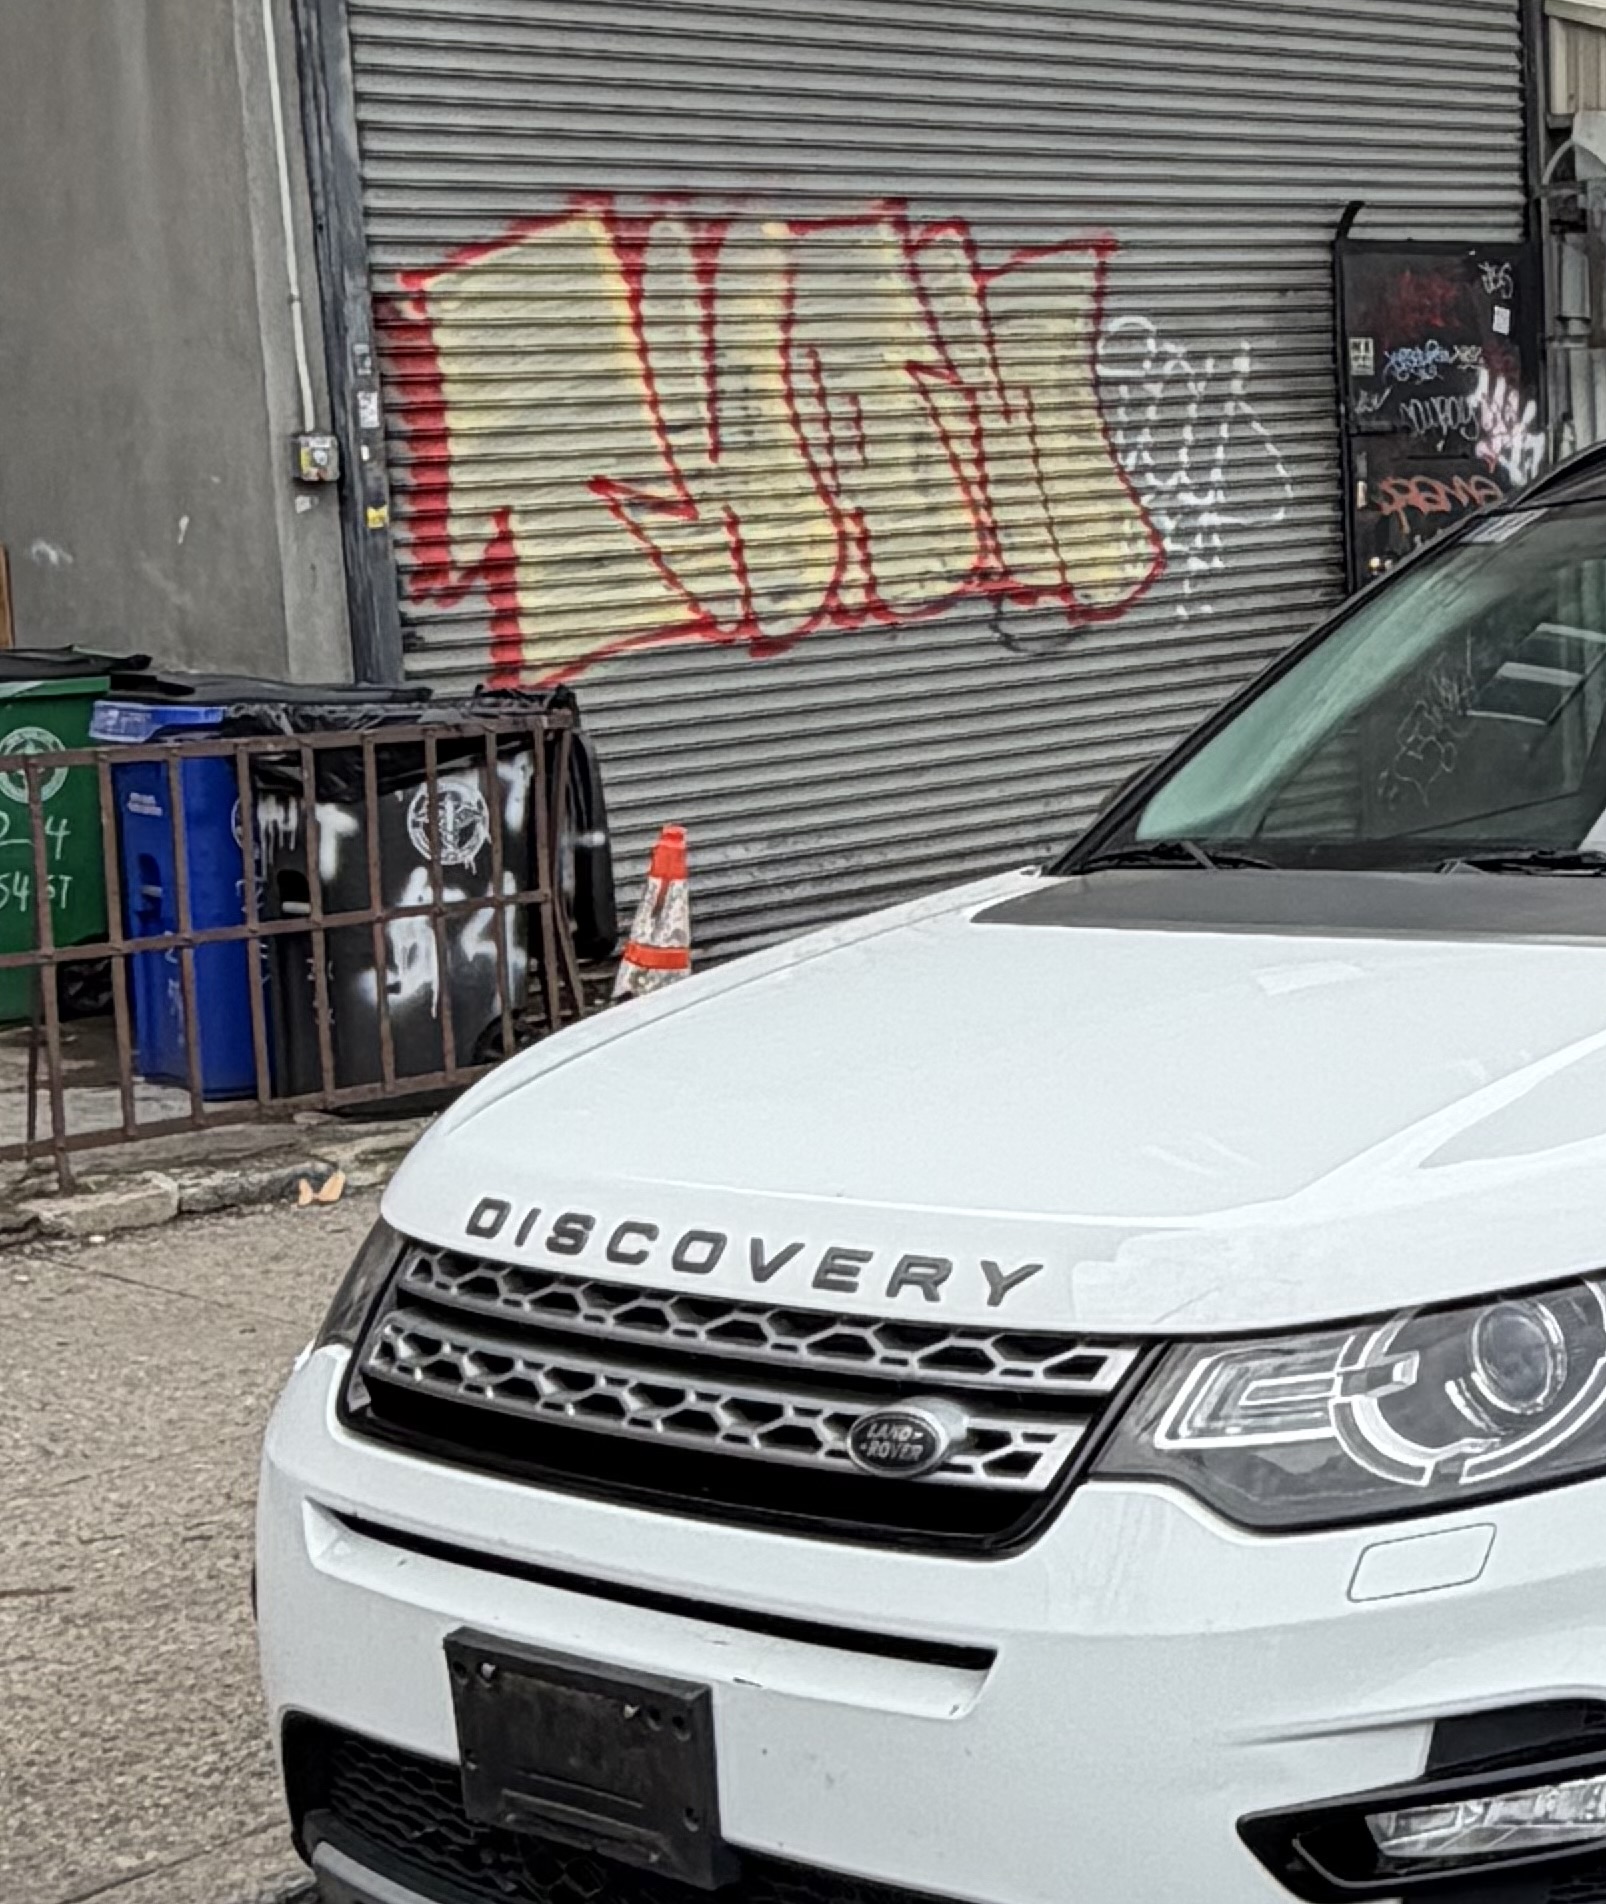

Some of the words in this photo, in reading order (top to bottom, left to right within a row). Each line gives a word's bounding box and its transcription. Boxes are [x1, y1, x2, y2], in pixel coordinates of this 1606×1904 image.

[464, 1196, 1044, 1307] DISCOVERY
[866, 1422, 913, 1441] LAND
[866, 1440, 923, 1460] ROVER
